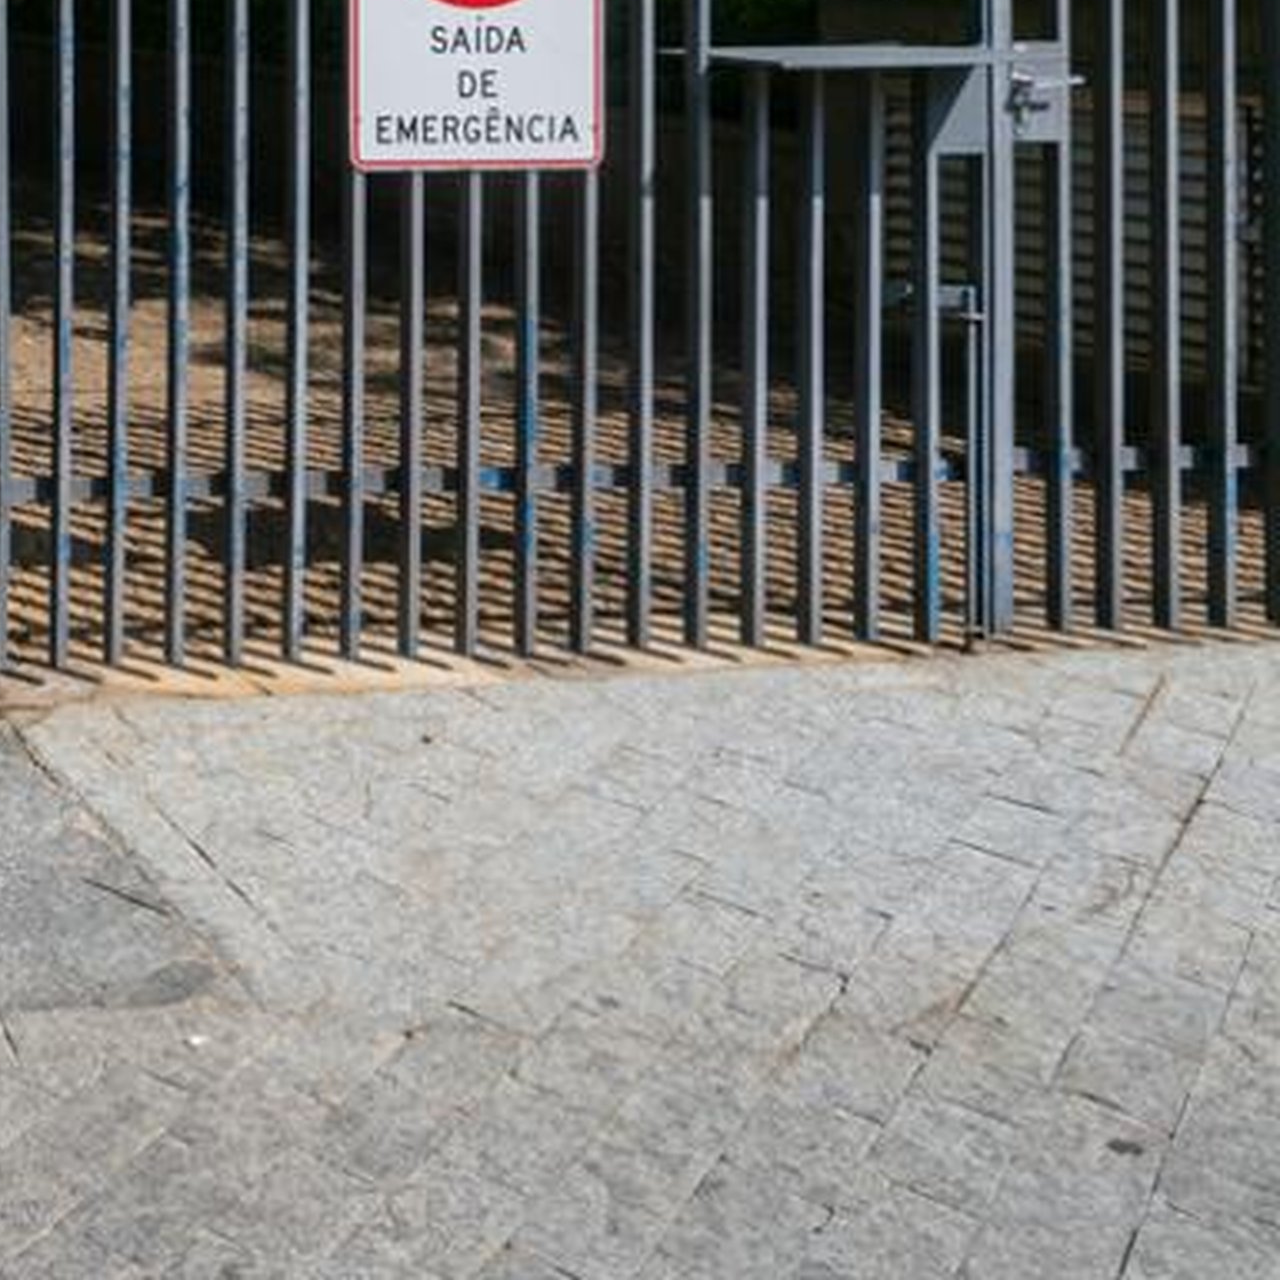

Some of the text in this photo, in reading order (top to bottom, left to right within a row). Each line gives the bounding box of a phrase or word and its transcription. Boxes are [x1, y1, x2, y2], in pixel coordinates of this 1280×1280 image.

[429, 15, 527, 54] SAÍDA
[457, 70, 499, 98] DE
[375, 106, 580, 145] EMERGÊNCIA
